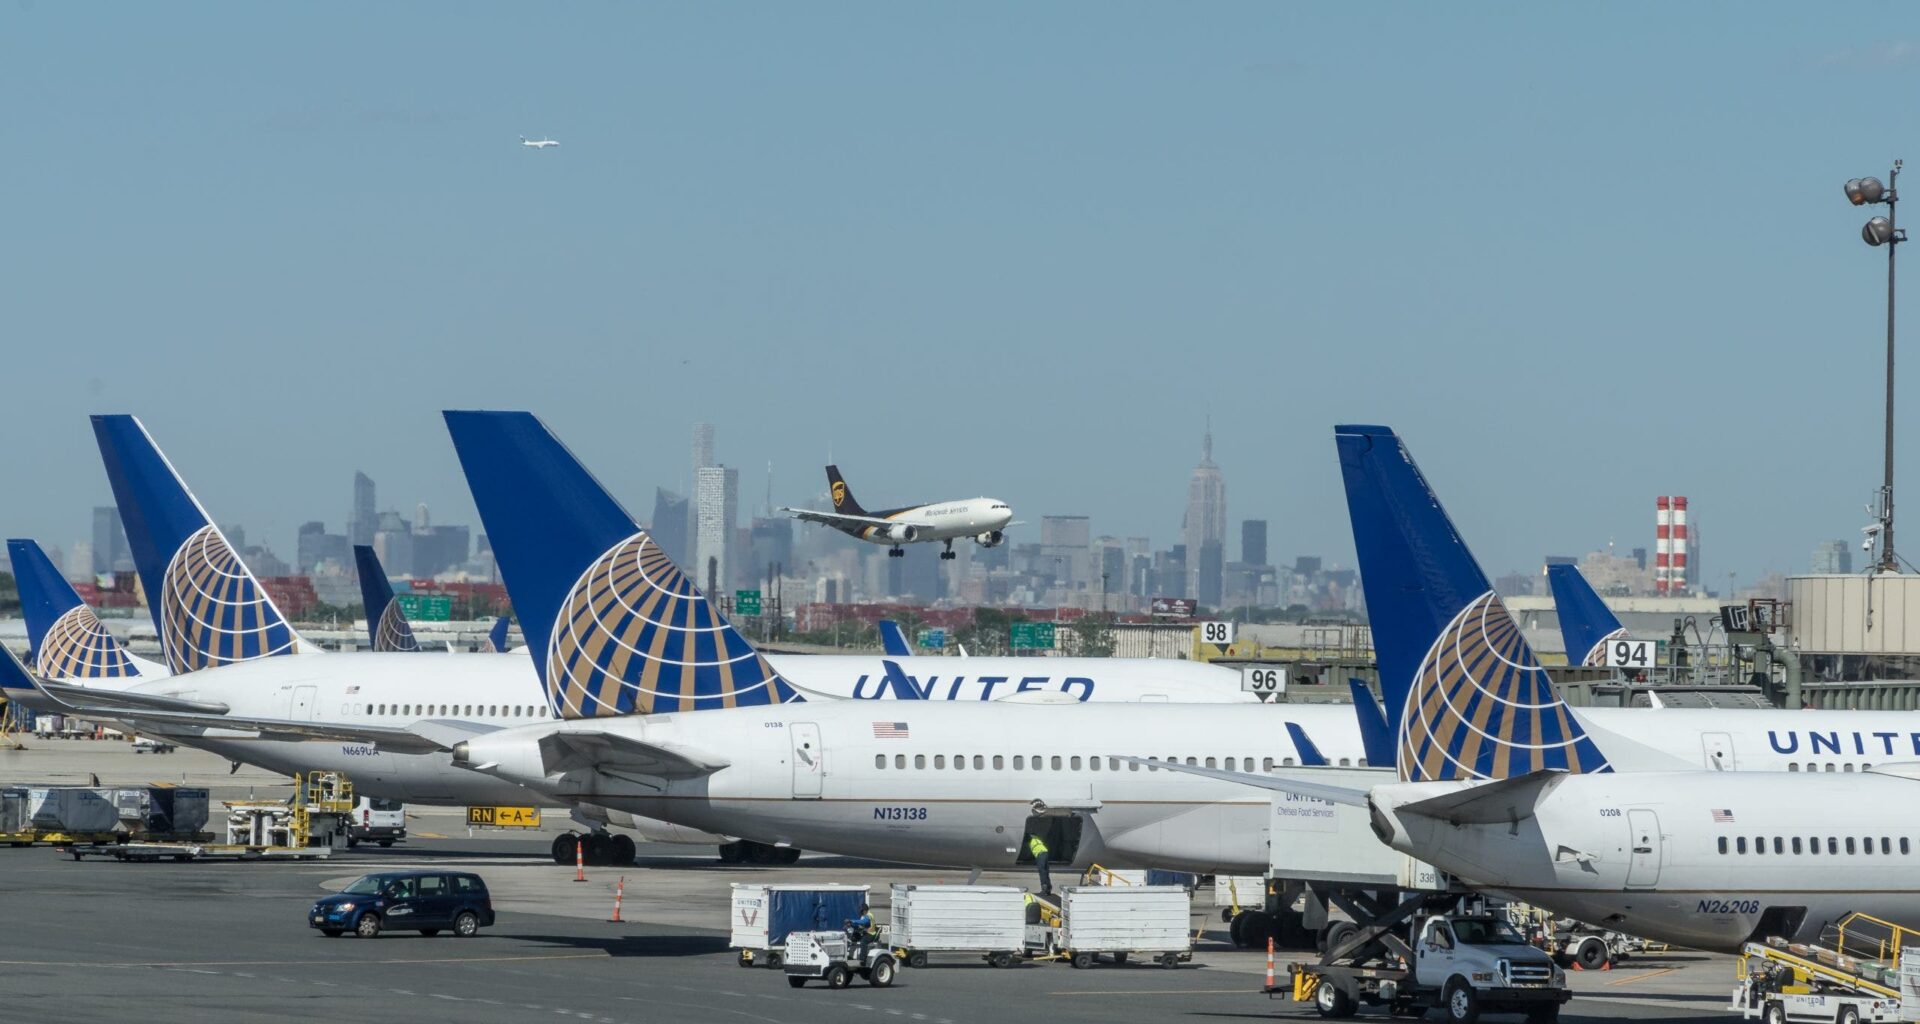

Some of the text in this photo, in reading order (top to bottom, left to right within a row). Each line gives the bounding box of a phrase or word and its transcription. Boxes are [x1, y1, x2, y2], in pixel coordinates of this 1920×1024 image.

[1206, 623, 1226, 641] 98
[1615, 641, 1648, 666] 94
[1252, 670, 1277, 690] 96
[472, 808, 523, 822] RN A
[874, 807, 927, 820] N13138
[1277, 806, 1334, 818] Chelsea Food Services
[1600, 808, 1621, 816] 0208
[1420, 872, 1435, 883] 338
[1696, 900, 1760, 914] N26208
